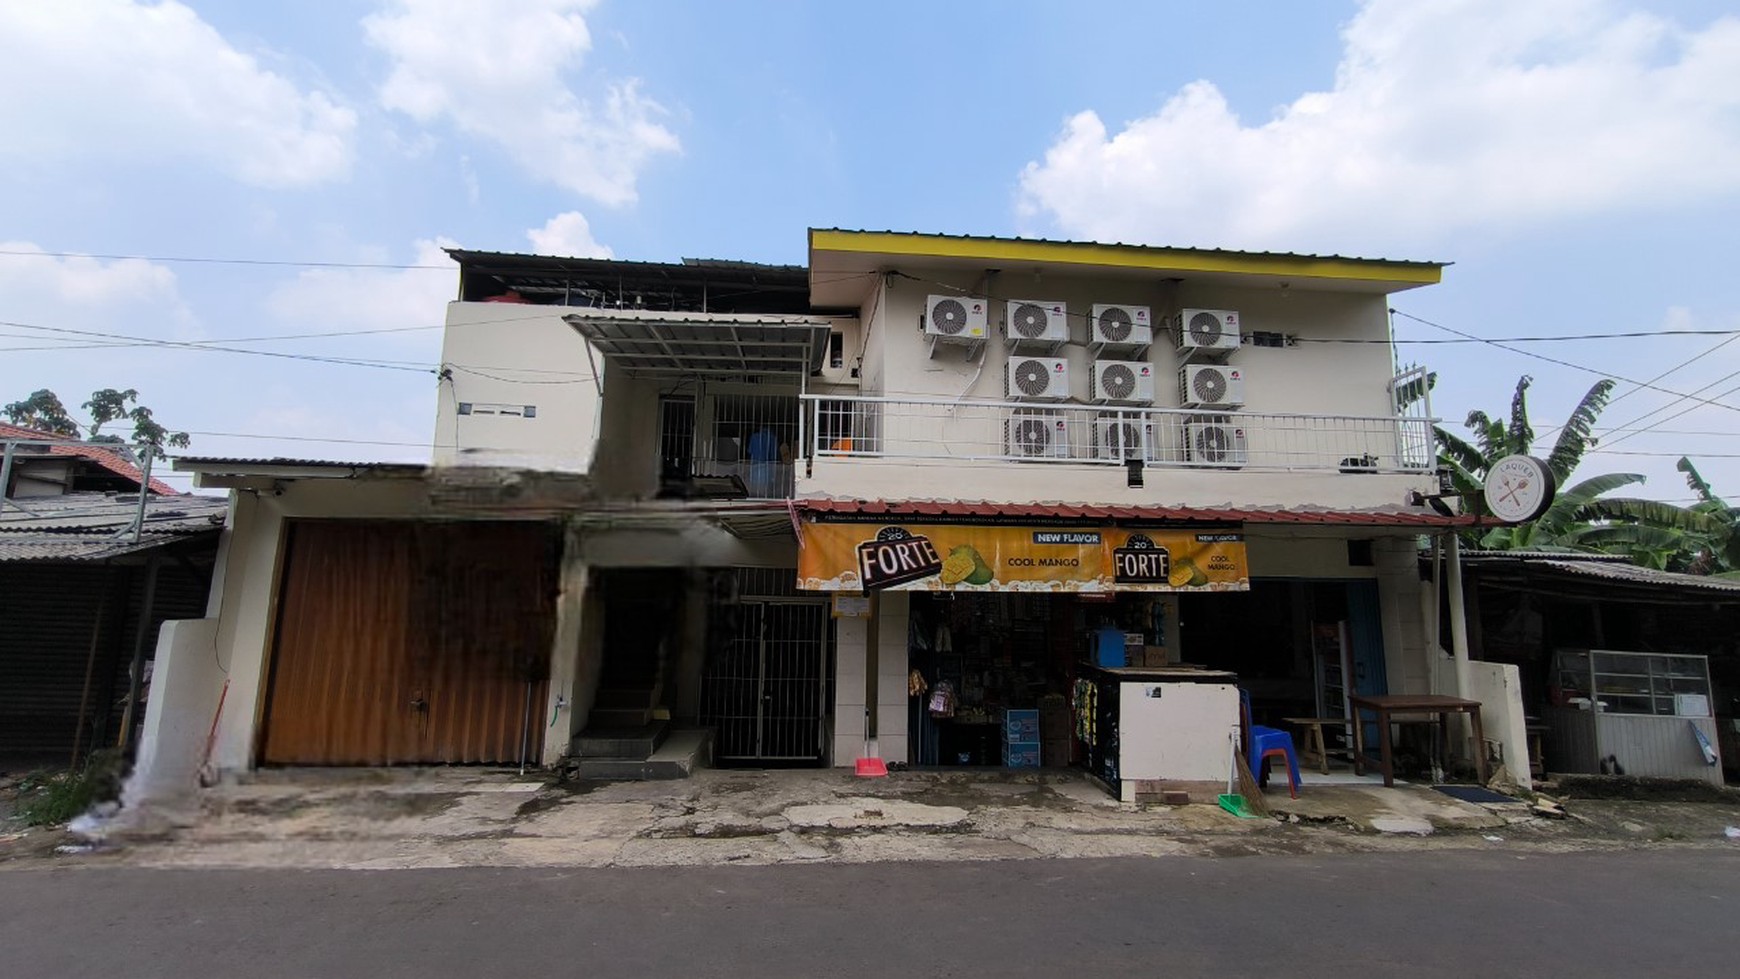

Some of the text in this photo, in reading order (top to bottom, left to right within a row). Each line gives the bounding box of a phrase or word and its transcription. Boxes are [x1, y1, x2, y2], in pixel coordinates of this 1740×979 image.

[1037, 534, 1099, 542] NEW FLAVOR
[1134, 541, 1147, 549] 20
[861, 541, 940, 580] FORTE
[1008, 558, 1079, 567] COOL MANGO
[1210, 555, 1230, 563] COOL
[1115, 553, 1168, 578] FORTE
[1207, 563, 1236, 571] MANGO
